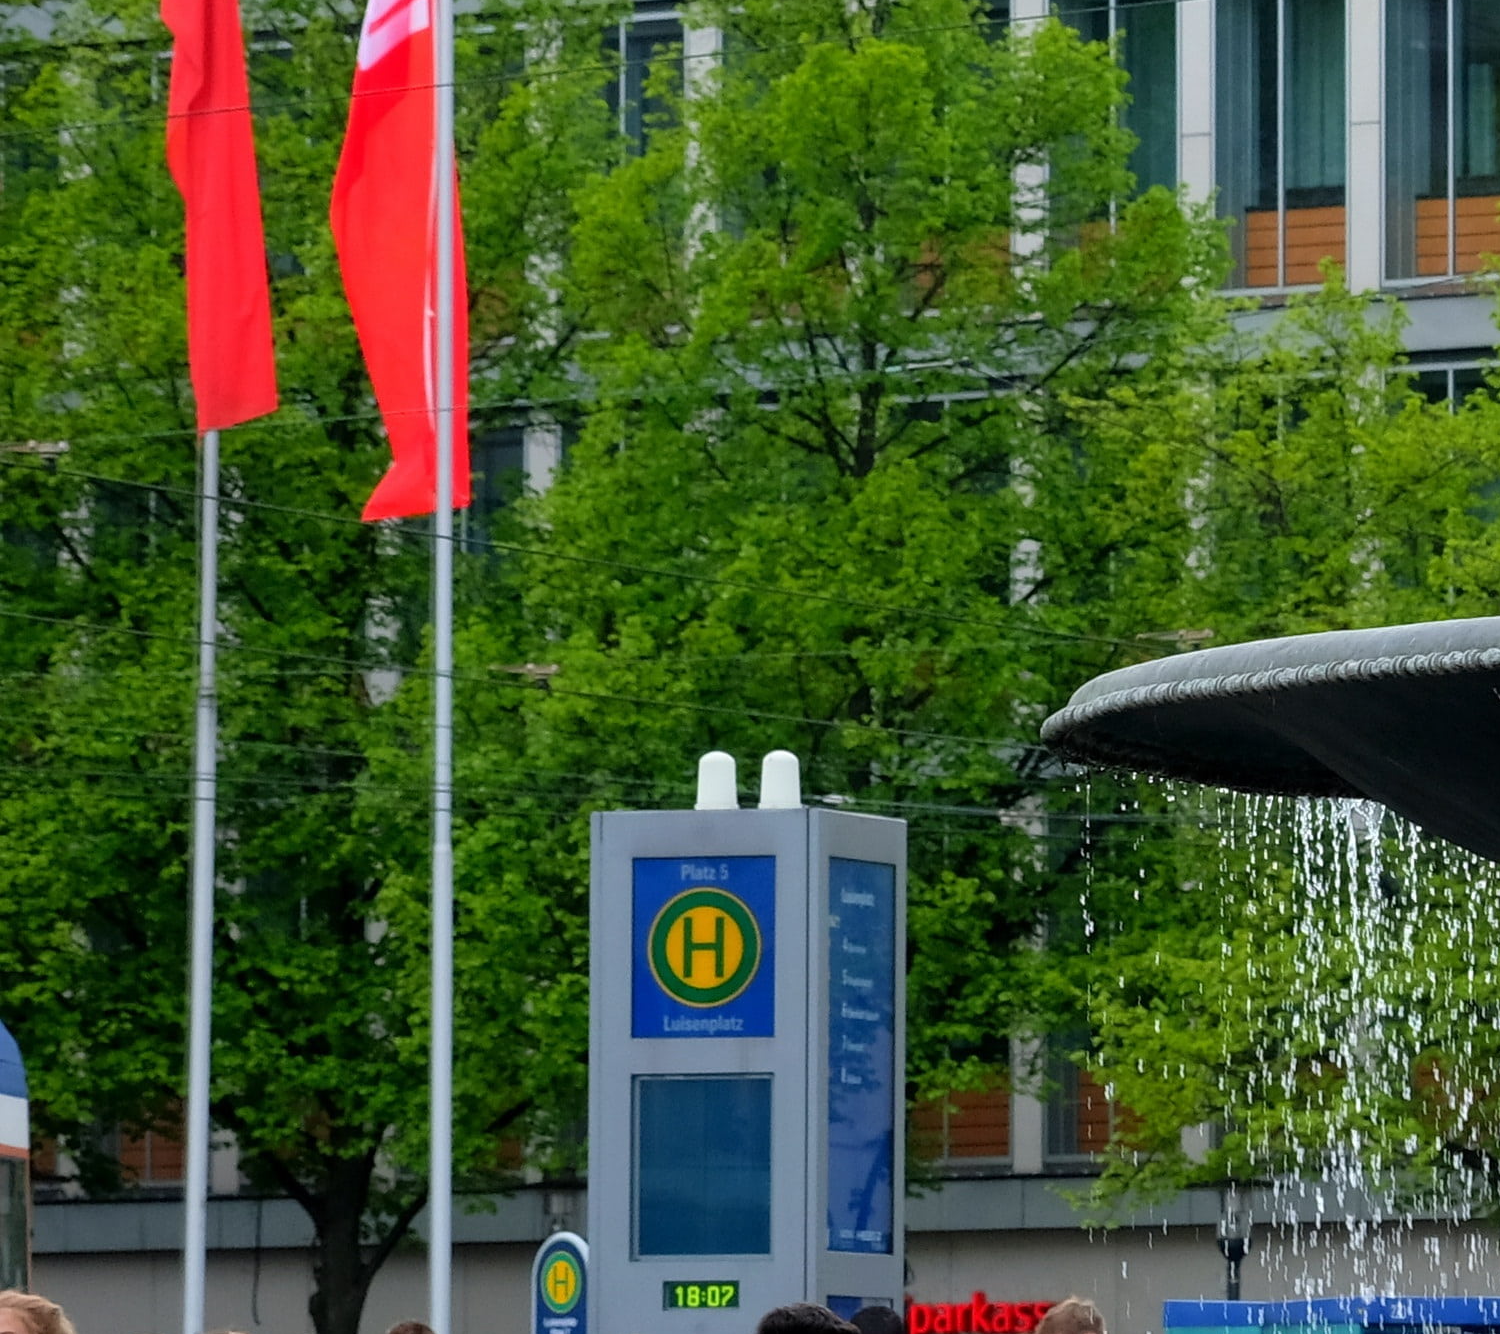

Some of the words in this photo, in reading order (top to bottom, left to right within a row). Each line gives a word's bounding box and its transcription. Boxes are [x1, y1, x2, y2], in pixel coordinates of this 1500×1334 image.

[680, 864, 716, 881] Platz
[720, 863, 729, 881] 5
[683, 916, 725, 978] H
[663, 1015, 744, 1035] Luisenplatz
[553, 1265, 569, 1300] H
[674, 1285, 735, 1307] 18:07
